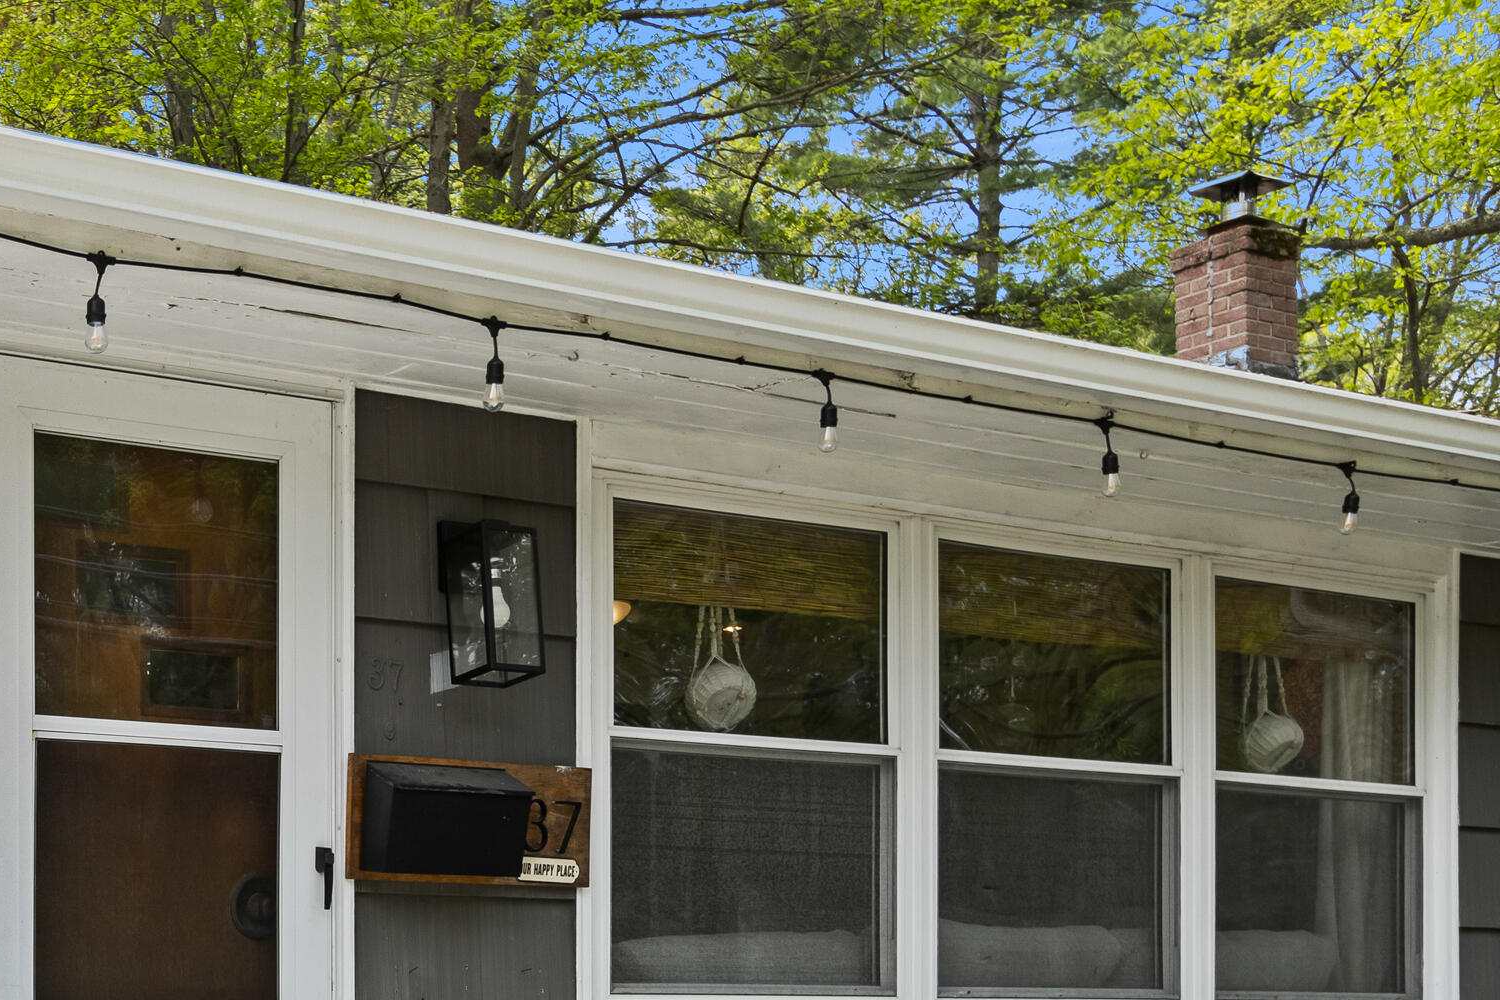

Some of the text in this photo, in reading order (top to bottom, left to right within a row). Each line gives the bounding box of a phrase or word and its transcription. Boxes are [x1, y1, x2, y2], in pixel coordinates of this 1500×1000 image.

[368, 657, 404, 692] 37
[523, 799, 582, 854] 37
[534, 863, 555, 876] HAPPY
[556, 864, 576, 877] PLACE
